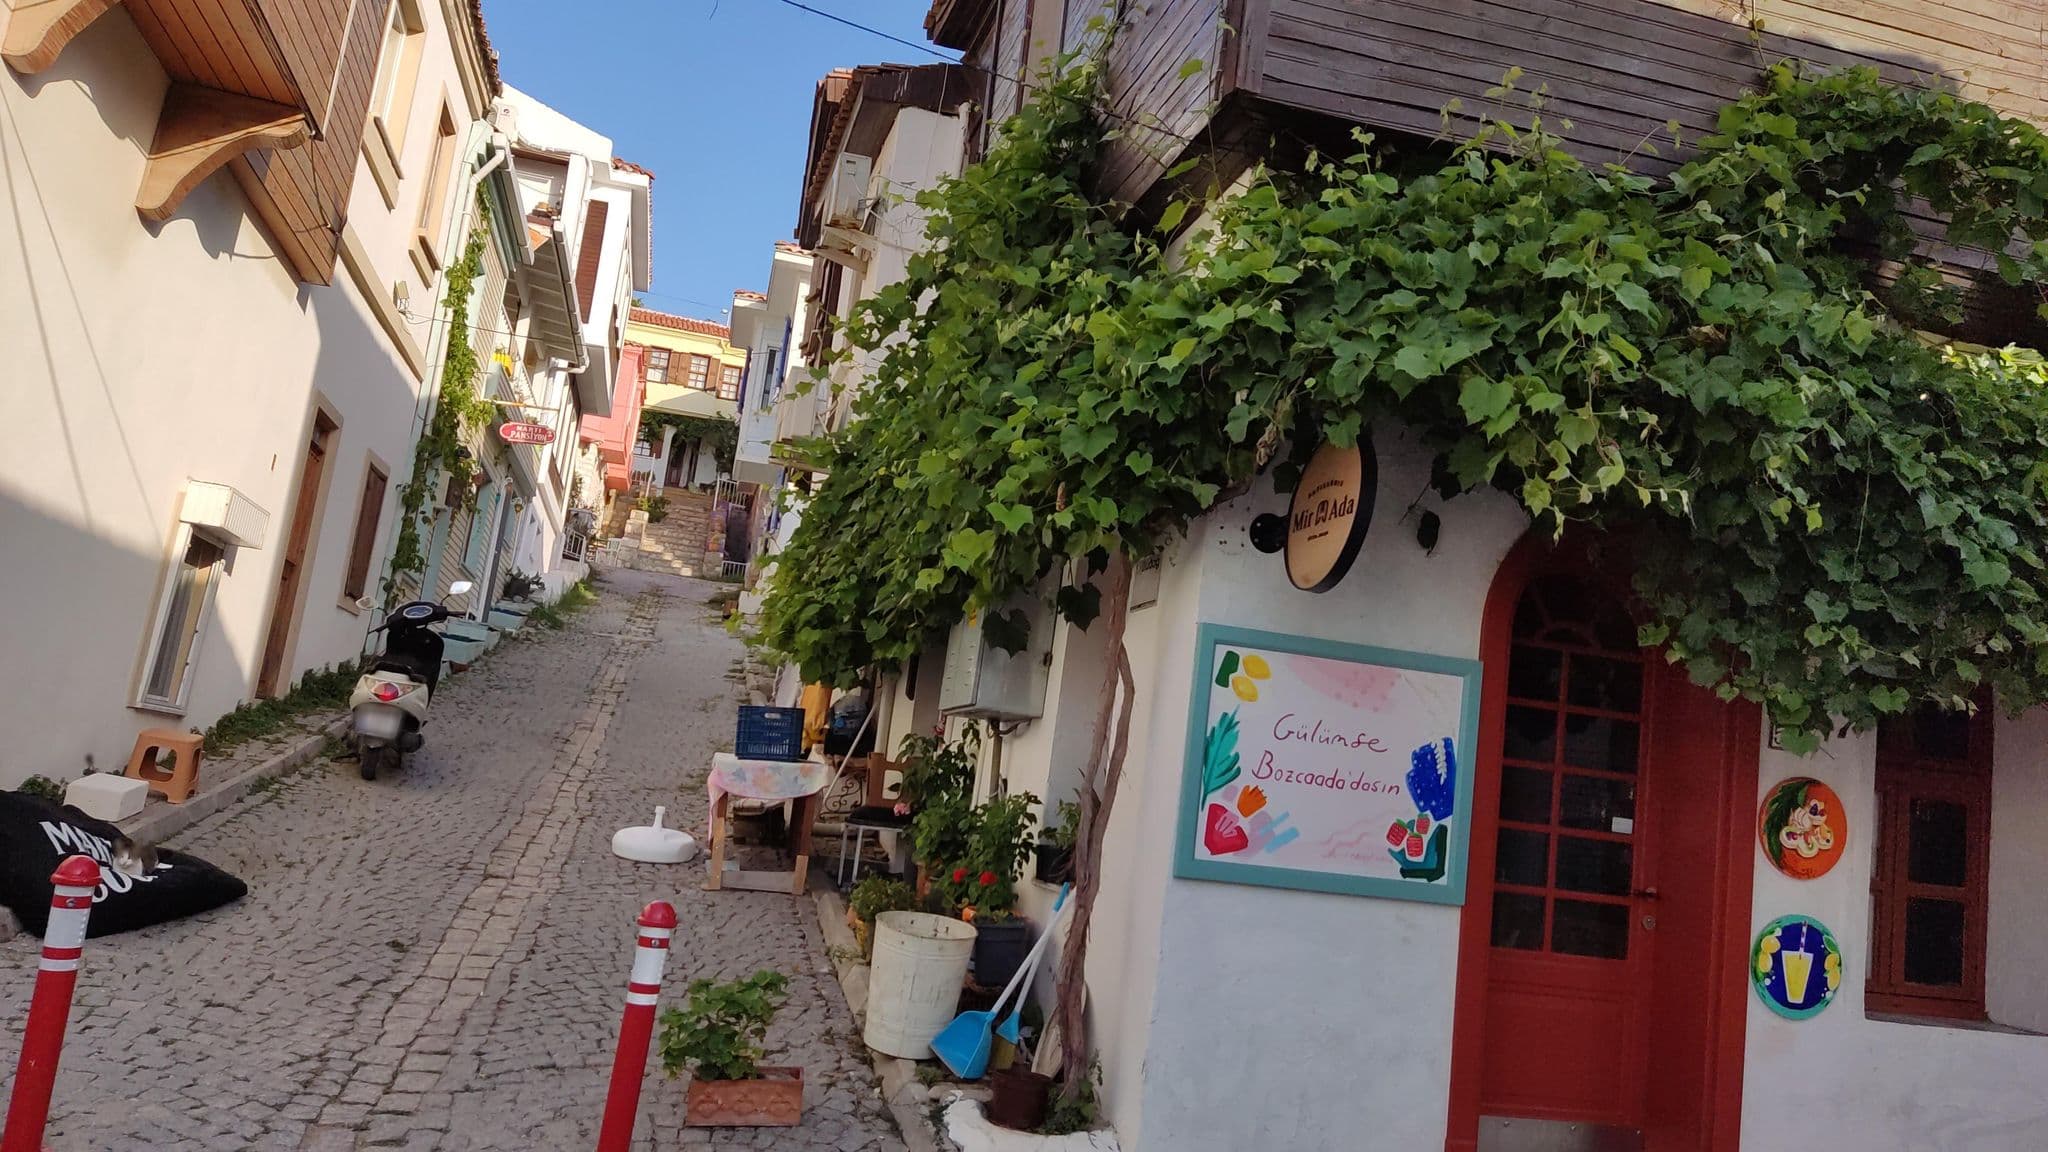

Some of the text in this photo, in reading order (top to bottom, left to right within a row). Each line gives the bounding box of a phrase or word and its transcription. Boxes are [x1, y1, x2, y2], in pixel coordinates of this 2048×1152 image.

[1292, 494, 1355, 534] Mir Ada
[1273, 713, 1388, 753] Gülümse
[1251, 749, 1400, 795] Bozcaada'dasın
